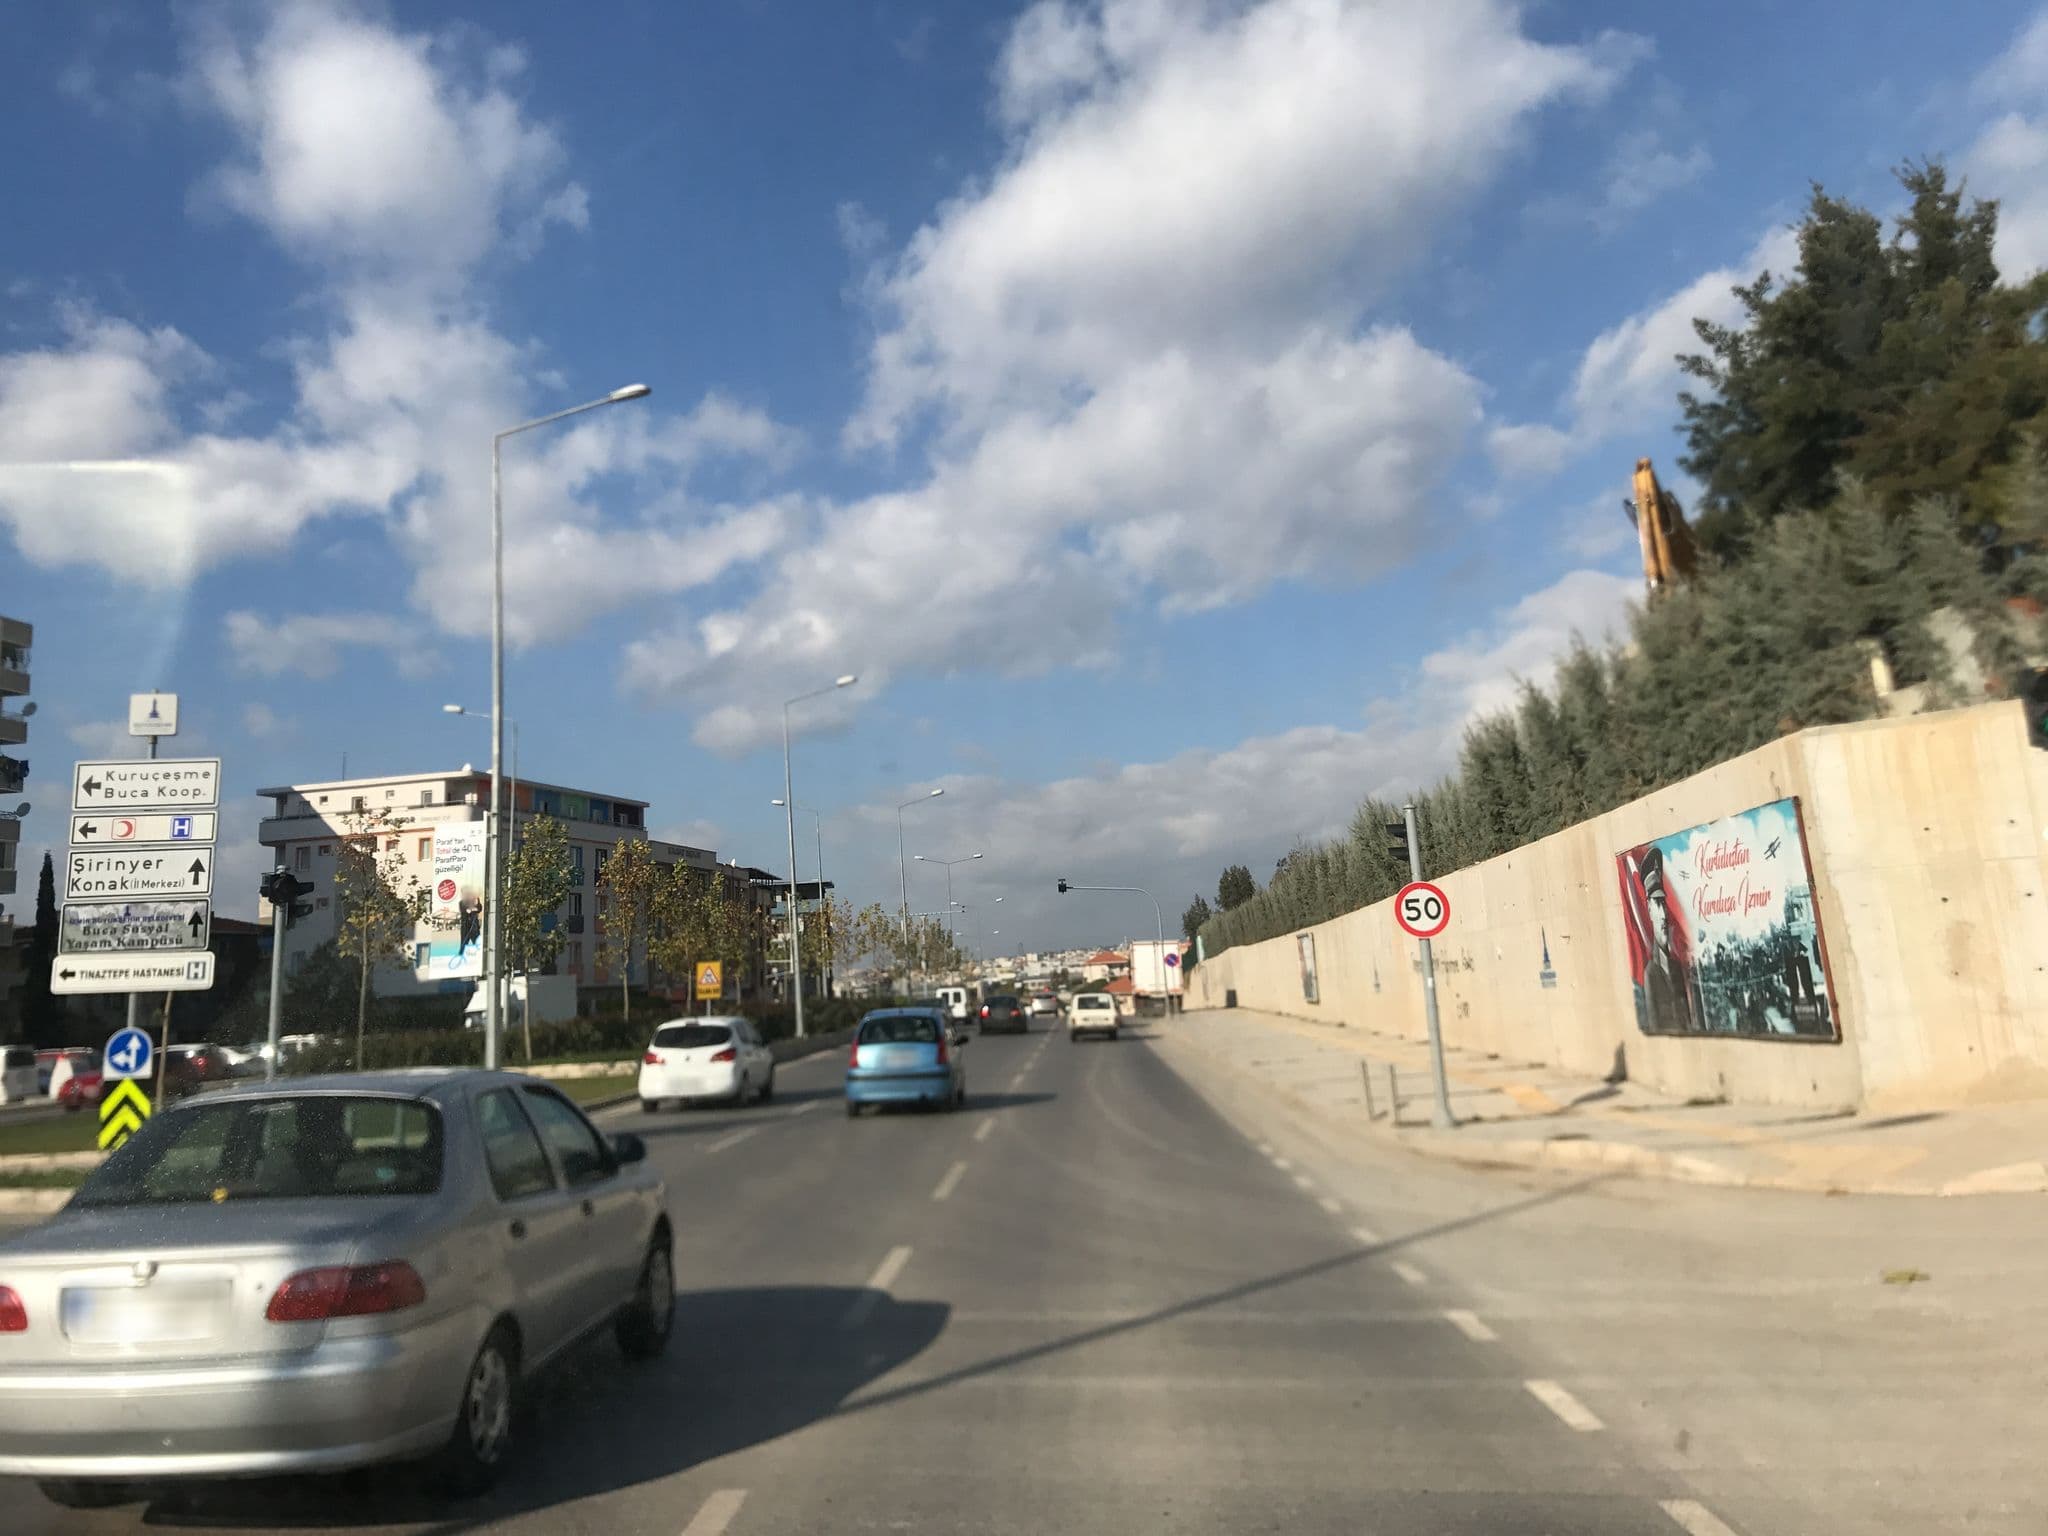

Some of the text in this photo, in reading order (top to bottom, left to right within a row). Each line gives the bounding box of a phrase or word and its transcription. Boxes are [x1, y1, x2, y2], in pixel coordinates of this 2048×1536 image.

[105, 770, 211, 782] Kuruçeşme
[104, 786, 207, 799] Buca Koop.
[74, 857, 164, 874] Şirinyer
[1695, 837, 1750, 879] Kurtuluştan
[70, 876, 129, 892] Konak
[141, 877, 185, 889] Merkezi)
[1692, 870, 1771, 923] Kuruluşa İzmir
[1404, 896, 1442, 922] 50
[83, 923, 169, 936] Buca Sosyal
[66, 935, 183, 950] Yaşam Kampüsü
